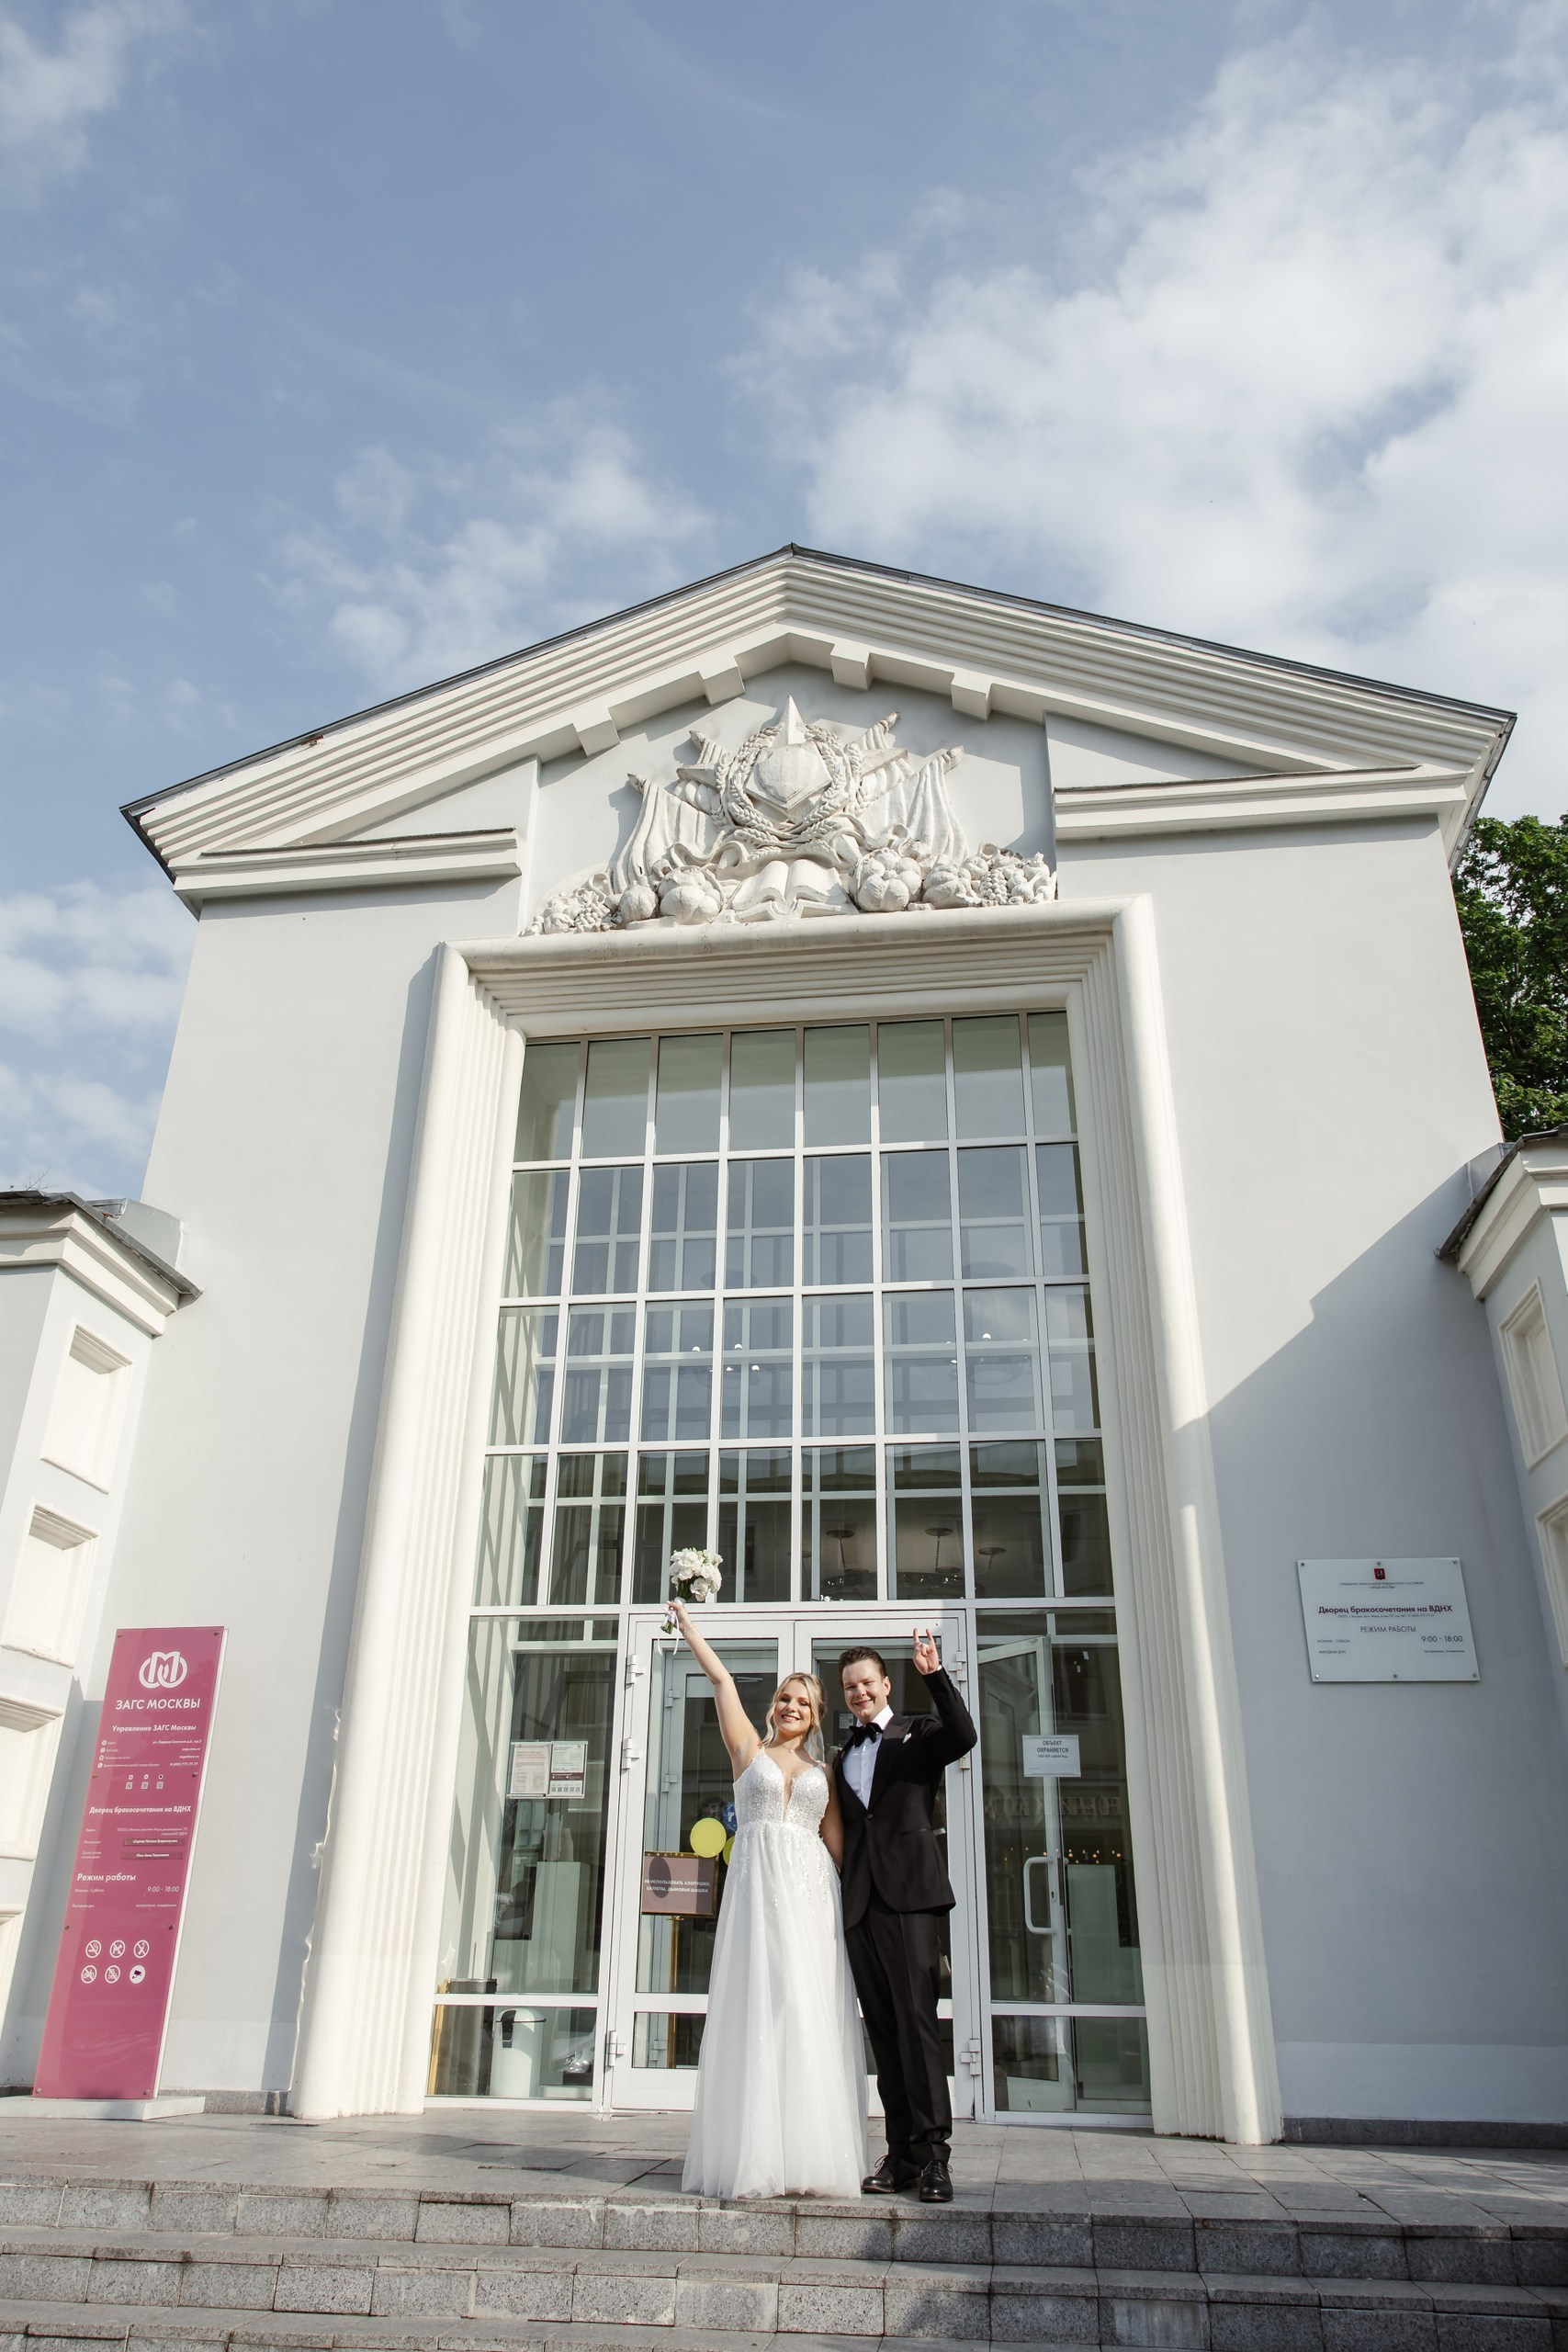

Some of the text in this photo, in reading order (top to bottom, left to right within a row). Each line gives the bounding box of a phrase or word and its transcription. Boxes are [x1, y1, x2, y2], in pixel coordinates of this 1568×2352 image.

[1318, 1606, 1349, 1615] Дворец
[1350, 1605, 1416, 1615] бракосочетания
[1428, 1605, 1453, 1613] ВДНХ
[116, 1698, 201, 1709] ЗАГС МОСКВЫ
[112, 1725, 152, 1734] Управление
[89, 1806, 113, 1815] Дворец
[114, 1805, 164, 1815] бракосочетания
[77, 1872, 136, 1883] Режим работы
